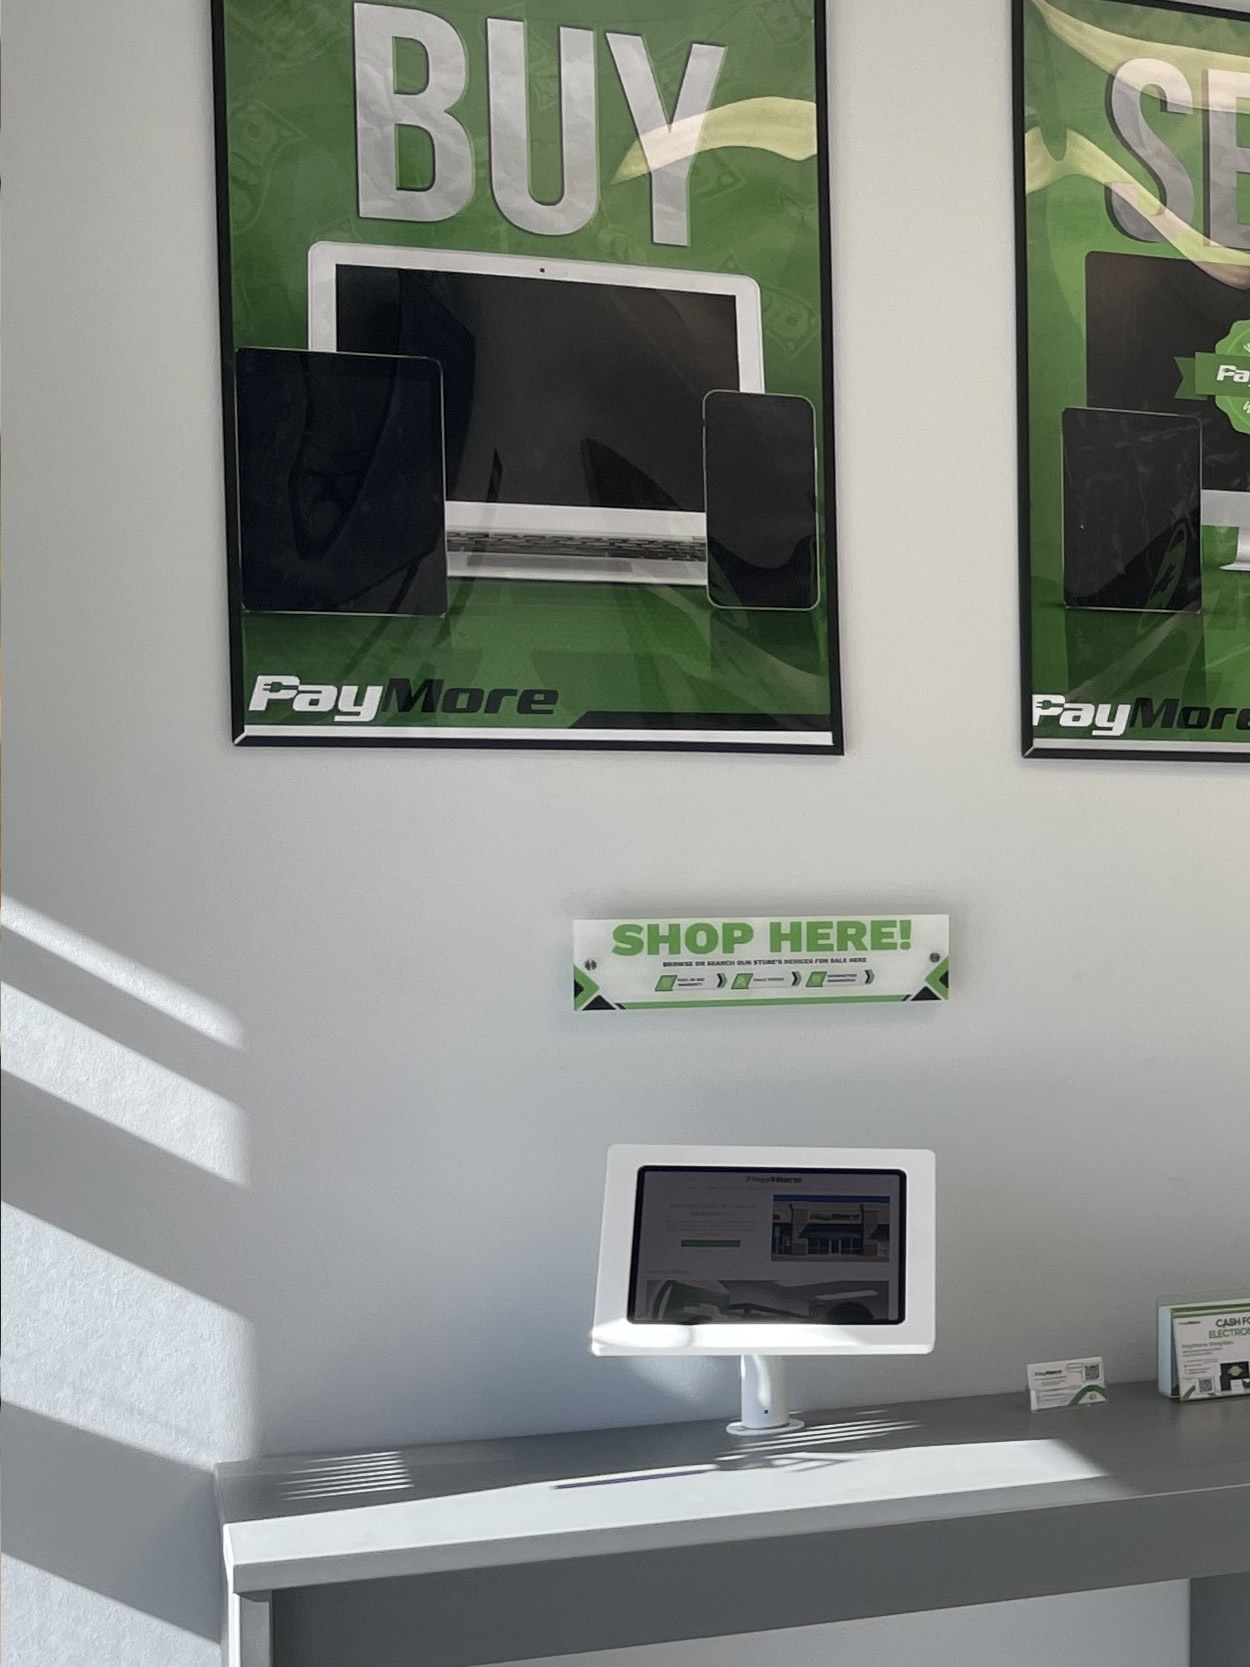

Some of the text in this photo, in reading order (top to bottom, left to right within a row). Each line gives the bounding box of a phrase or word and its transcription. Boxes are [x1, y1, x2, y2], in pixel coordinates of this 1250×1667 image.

[353, 2, 728, 247] BUY
[248, 674, 559, 722] PayMore
[612, 919, 912, 957] SHOP HERE!
[1215, 1317, 1241, 1328] CASH
